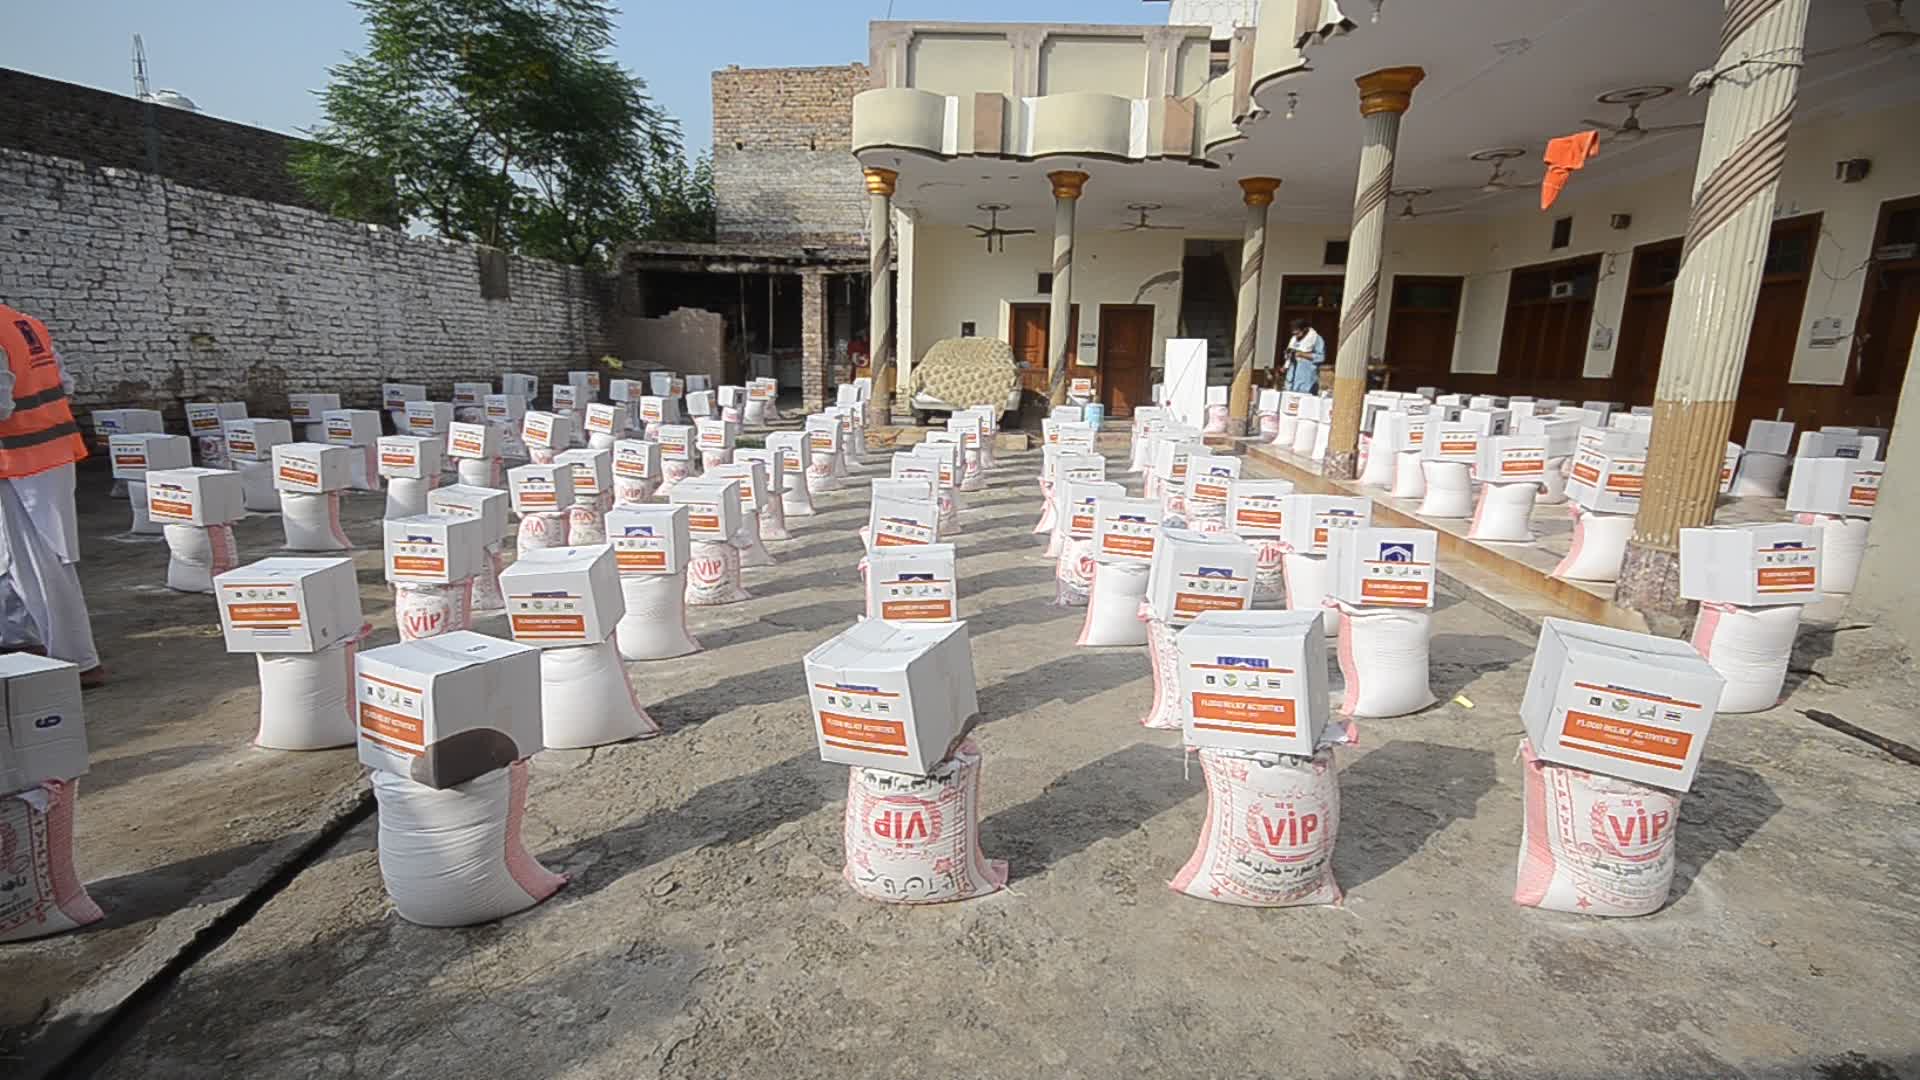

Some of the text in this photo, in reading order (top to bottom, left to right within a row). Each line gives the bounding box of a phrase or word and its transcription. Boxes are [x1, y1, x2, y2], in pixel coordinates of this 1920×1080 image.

[697, 559, 722, 576] VIP
[409, 609, 442, 632] VIP
[1575, 717, 1603, 731] FLOOD
[1602, 723, 1632, 737] RELIEF
[1631, 728, 1681, 746] ACTIVITIES
[874, 810, 929, 843] VIP
[1262, 810, 1319, 847] VIP
[1608, 807, 1670, 847] VIP
